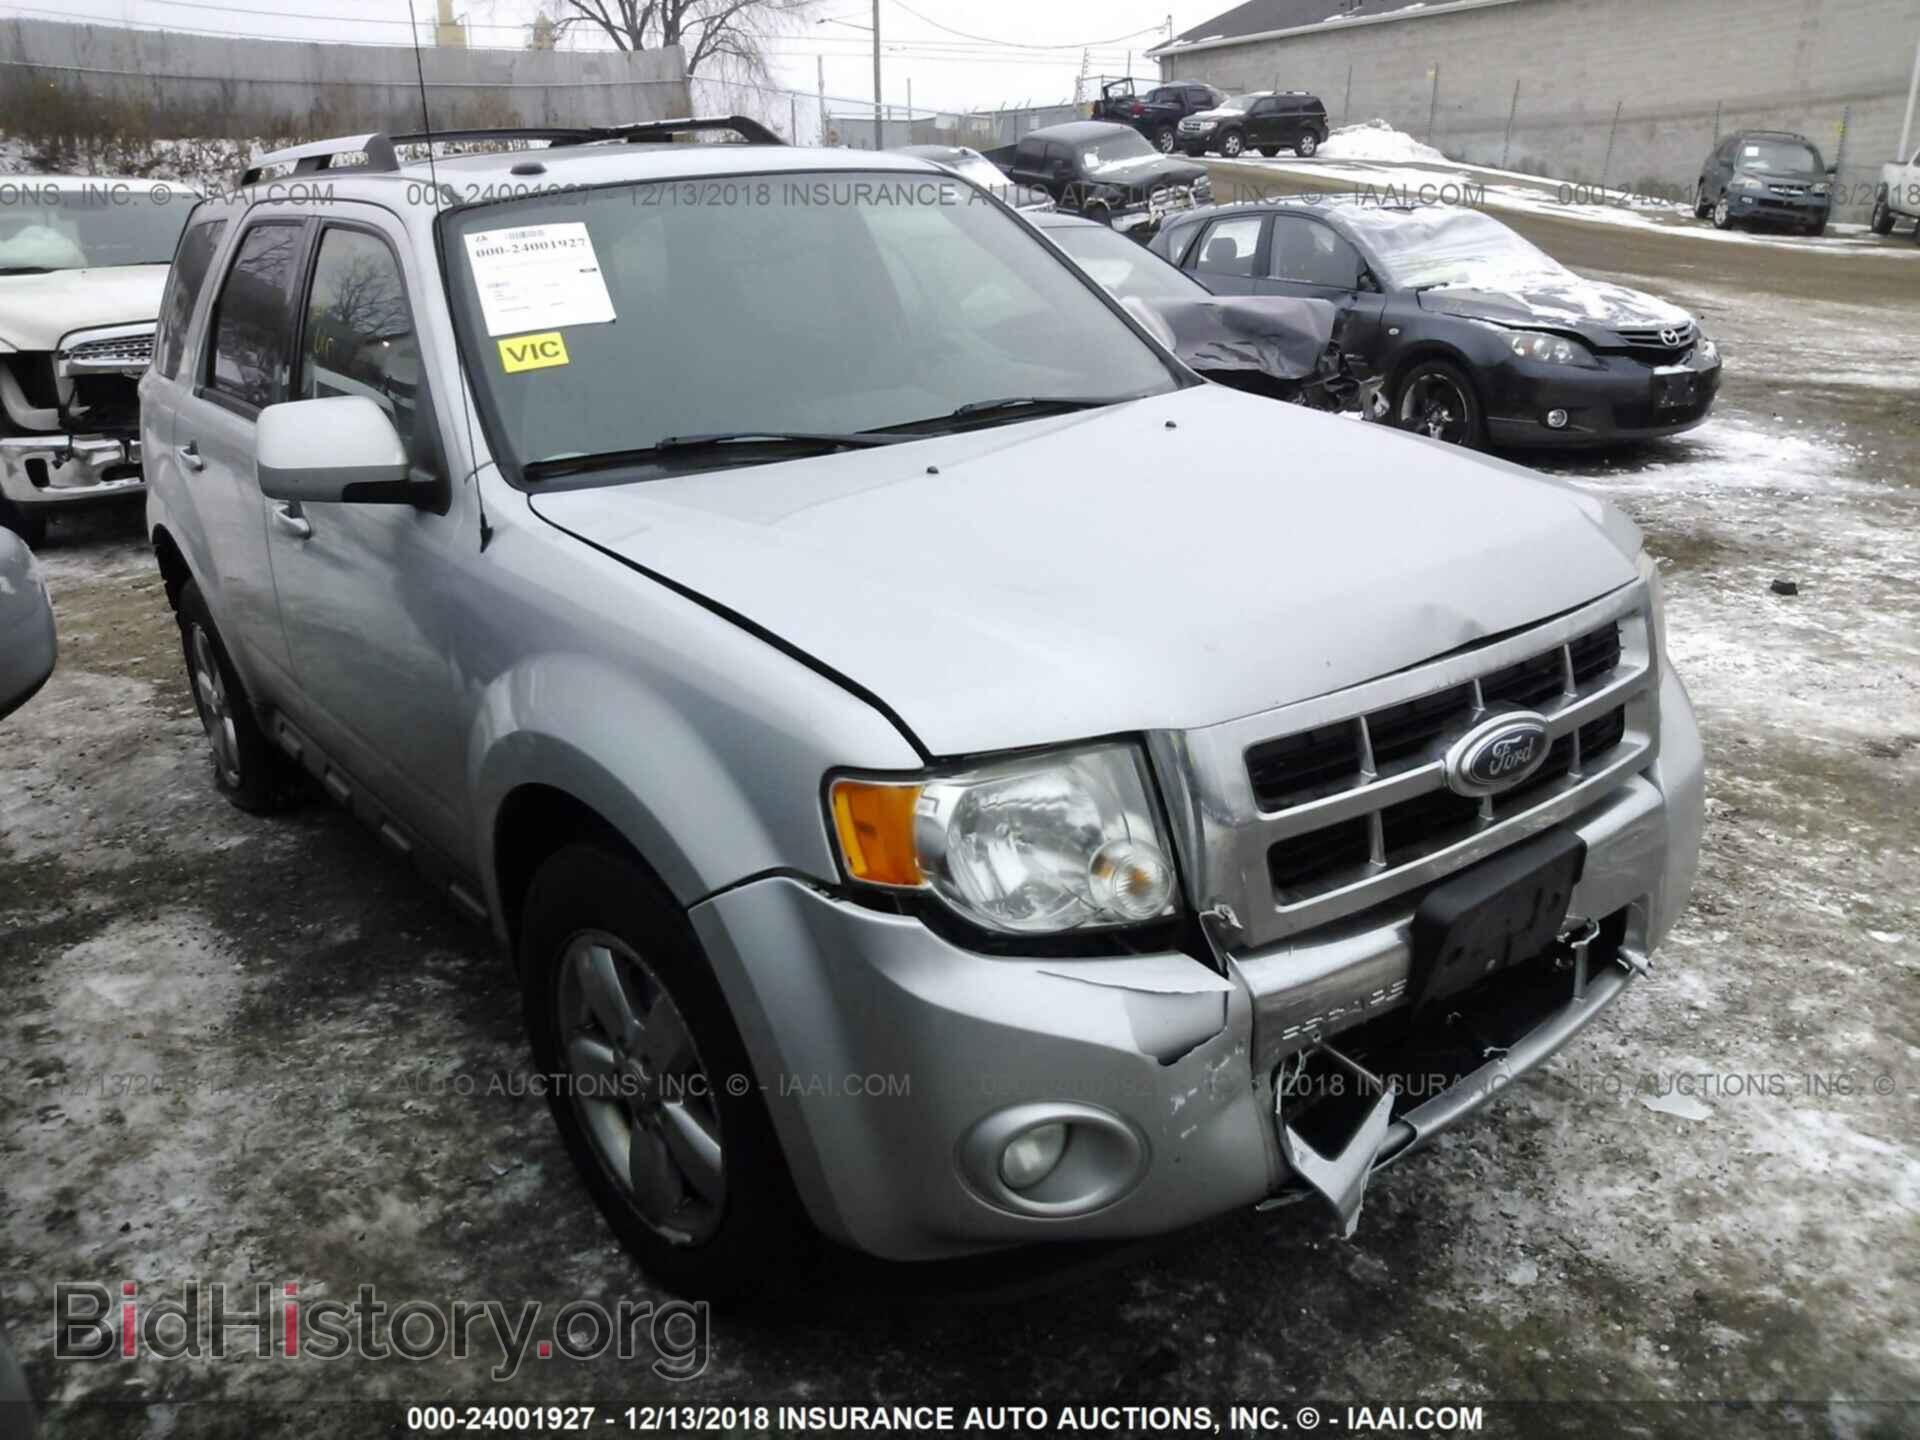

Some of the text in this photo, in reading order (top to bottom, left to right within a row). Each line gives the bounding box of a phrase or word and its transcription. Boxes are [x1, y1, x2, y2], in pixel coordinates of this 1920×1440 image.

[475, 238, 587, 259] 000-24001927
[506, 340, 561, 363] VIC
[1489, 735, 1535, 776] Ford
